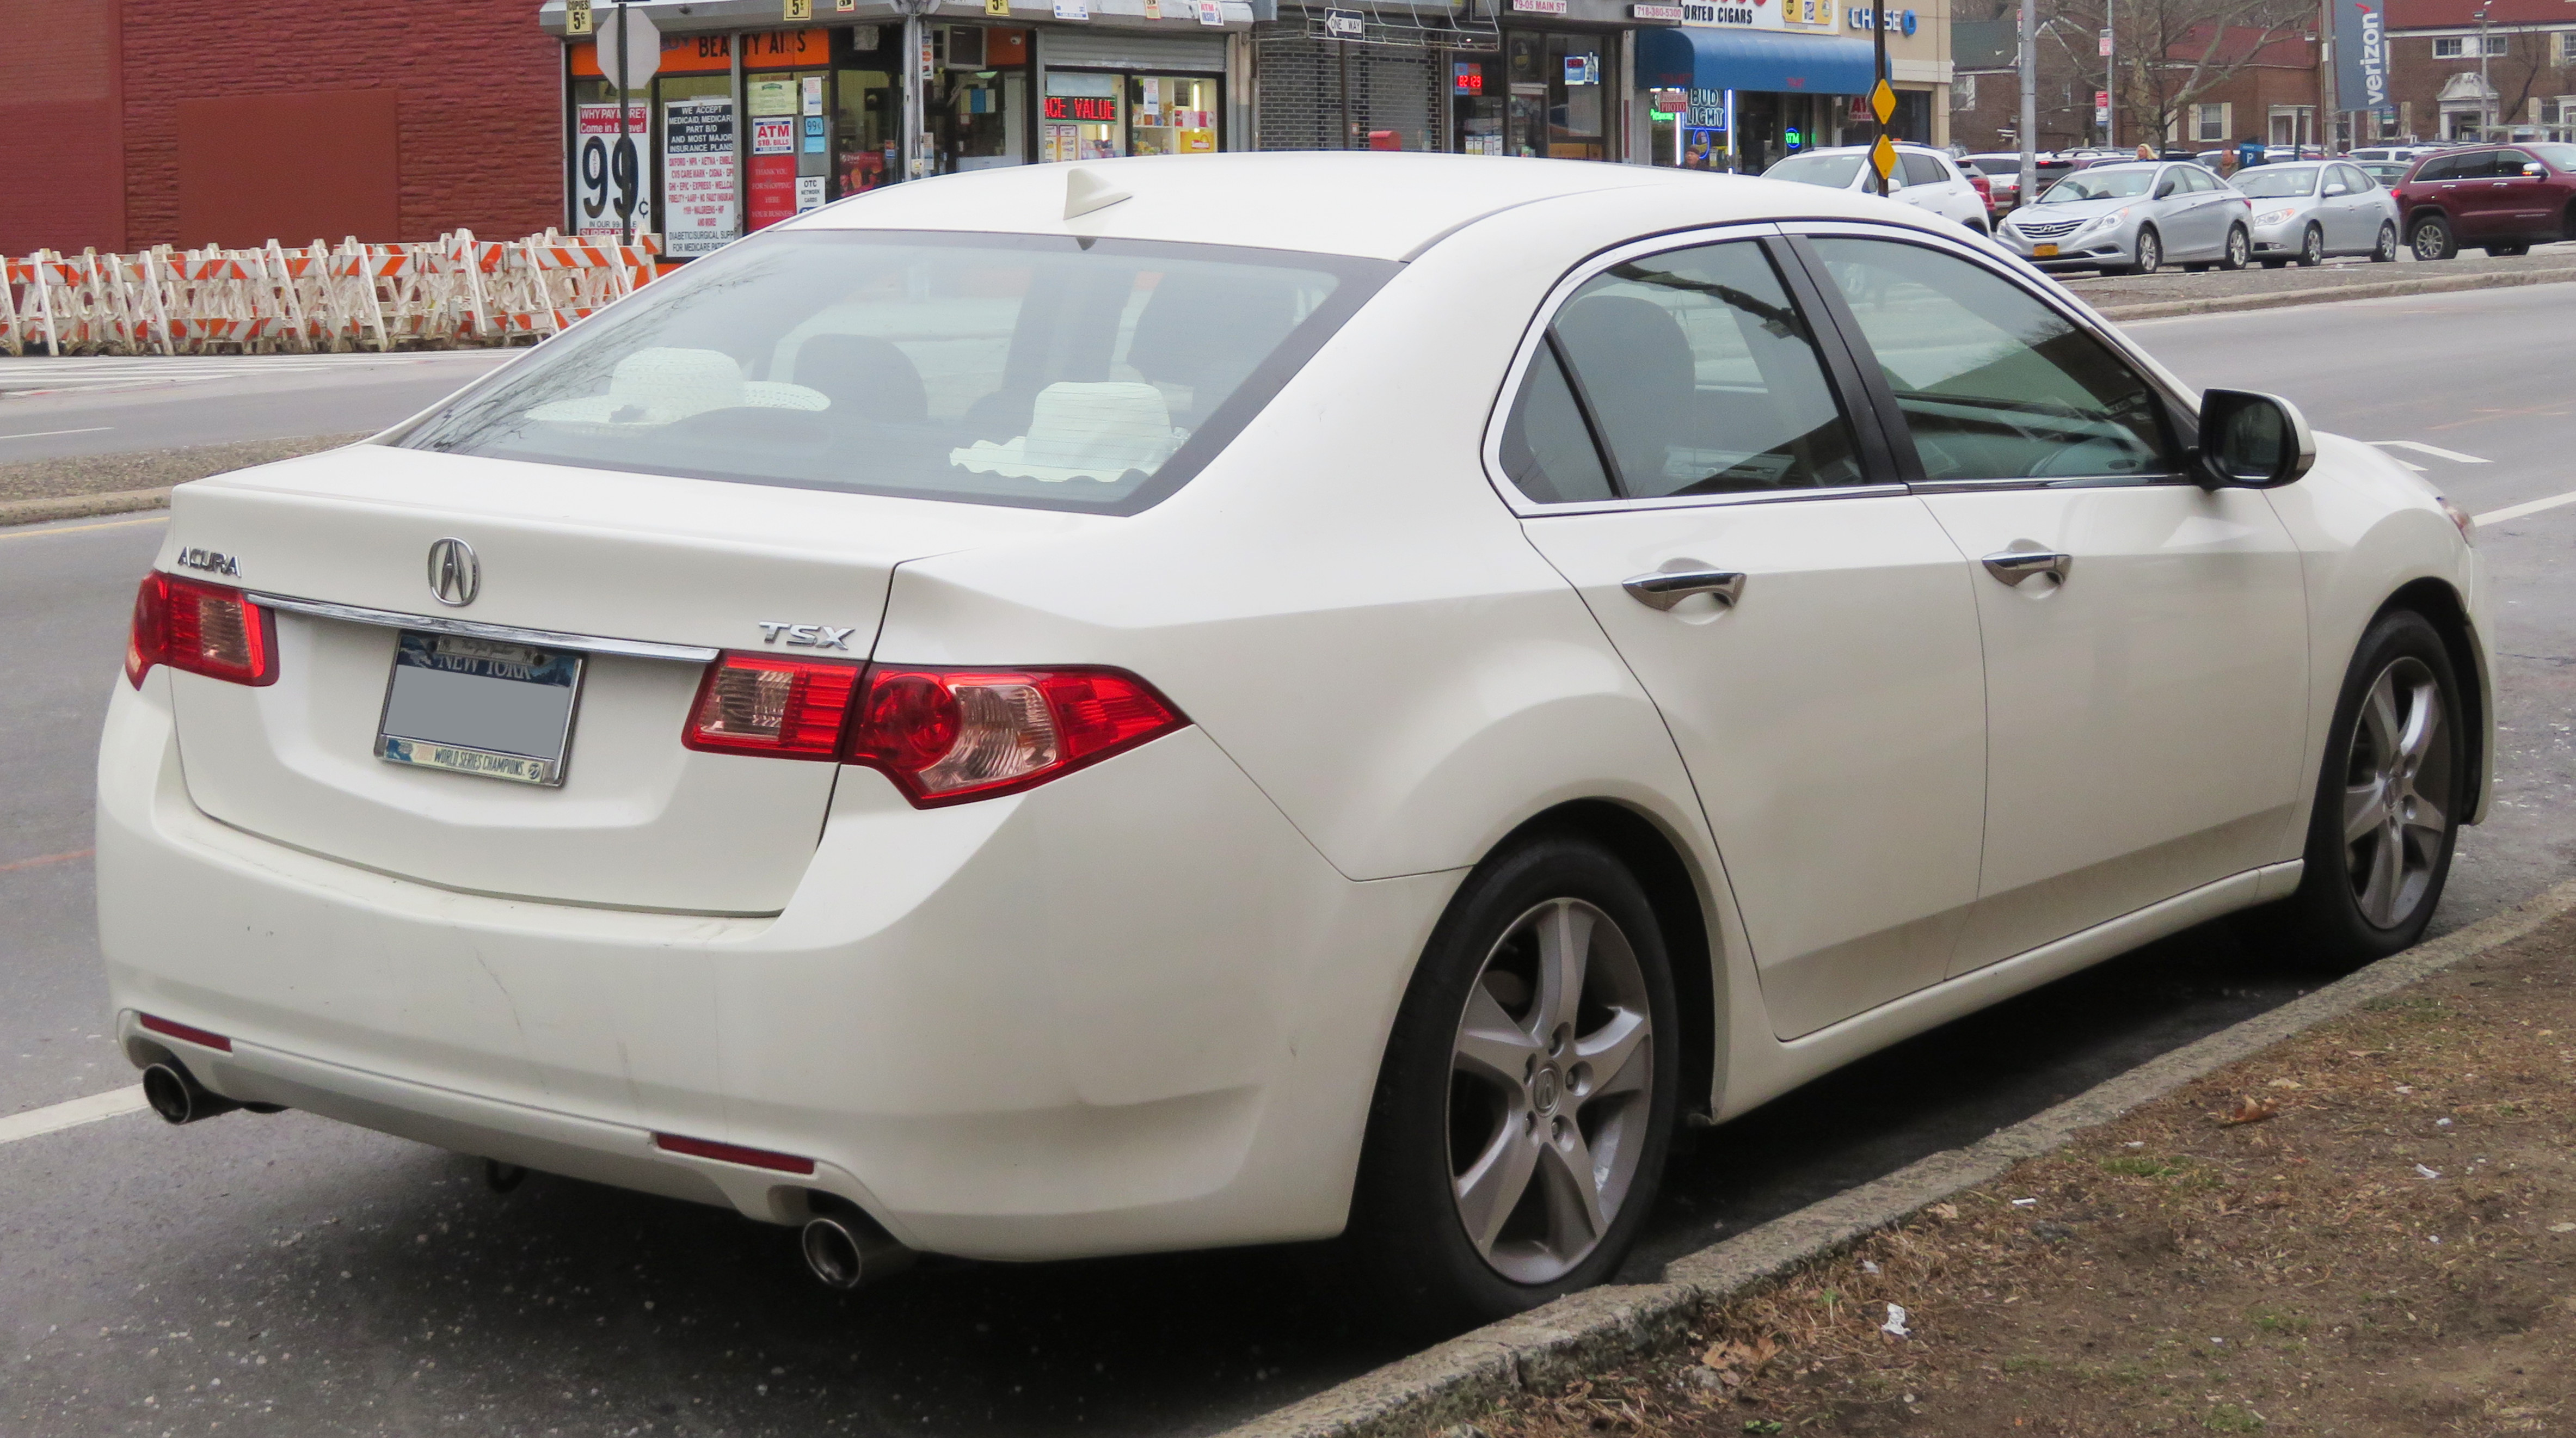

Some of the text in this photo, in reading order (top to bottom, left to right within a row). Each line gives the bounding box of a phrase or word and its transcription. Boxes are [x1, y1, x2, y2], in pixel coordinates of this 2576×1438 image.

[1201, 3, 1214, 11] ATM
[1515, 0, 1565, 11] 79-05 MAIN ST
[1637, 7, 1681, 18] 718-380-5300
[1718, 7, 1752, 24] CIGARS
[1331, 19, 1360, 31] ONE WAY
[1849, 8, 1902, 30] CHSE
[699, 34, 761, 57] BEATY
[769, 30, 806, 54] AIS
[2360, 13, 2384, 106] verizon
[1459, 75, 1481, 87] 82 129
[1690, 88, 1718, 106] BUD
[581, 108, 645, 119] WHY PAY MRE?
[696, 106, 723, 114] ACCEPT
[1074, 99, 1115, 120] VALUE
[1661, 103, 1685, 112] PHOTO
[1686, 107, 1724, 126] LIGHT
[581, 123, 603, 133] Come
[605, 123, 612, 132] in
[614, 122, 619, 132] &
[758, 125, 789, 138] ATM
[670, 144, 708, 152] INSURANCE
[669, 158, 685, 166] OXFORD
[702, 157, 716, 165] AETNA
[2247, 153, 2254, 164] P
[672, 170, 680, 179] CVS
[681, 170, 692, 178] CARE
[693, 169, 705, 177] MARK
[709, 169, 722, 177] CIGNA
[693, 181, 711, 190] EXPRESS
[178, 546, 242, 578] ACURA
[759, 621, 856, 650] TSX
[434, 748, 459, 766] WORLD
[459, 751, 483, 770] SERIES
